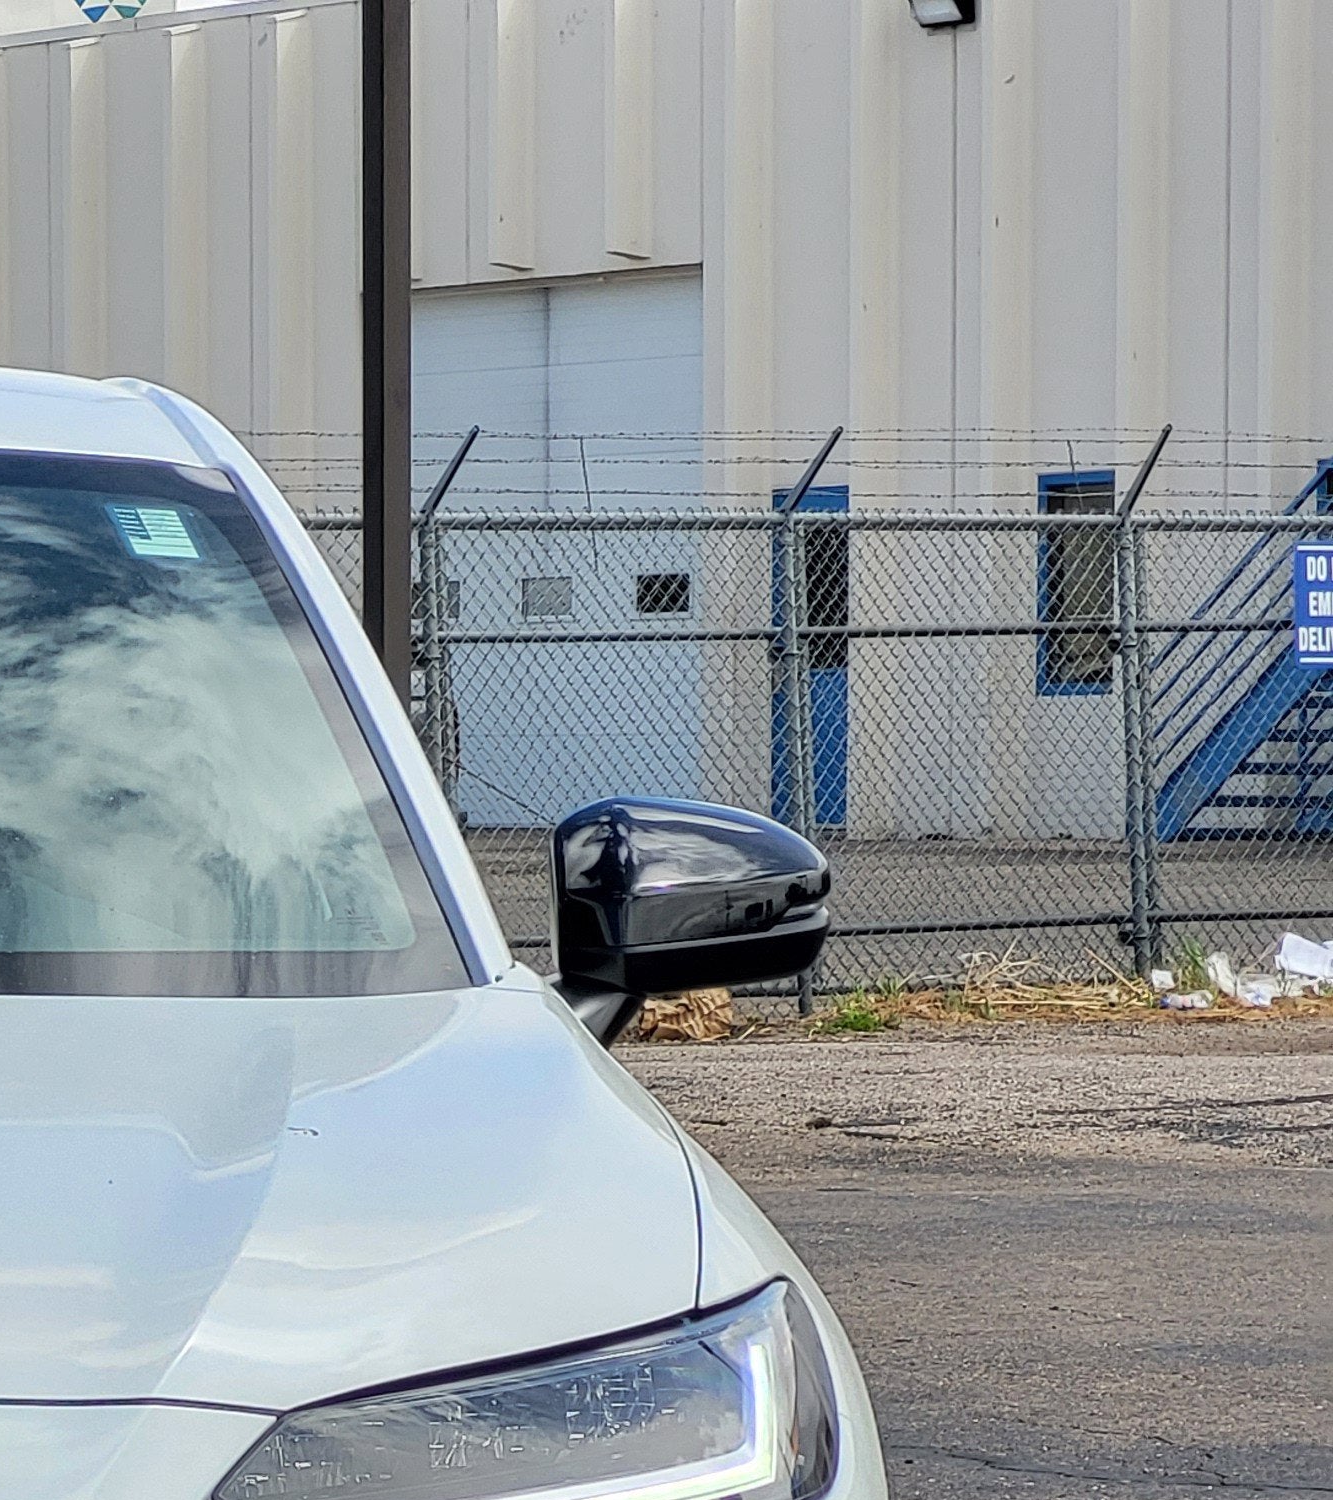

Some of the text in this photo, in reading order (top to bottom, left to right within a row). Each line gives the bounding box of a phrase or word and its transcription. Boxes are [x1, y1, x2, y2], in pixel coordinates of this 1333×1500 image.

[1306, 556, 1327, 581] DO
[1308, 591, 1333, 617] EM
[1298, 626, 1333, 652] DELI
